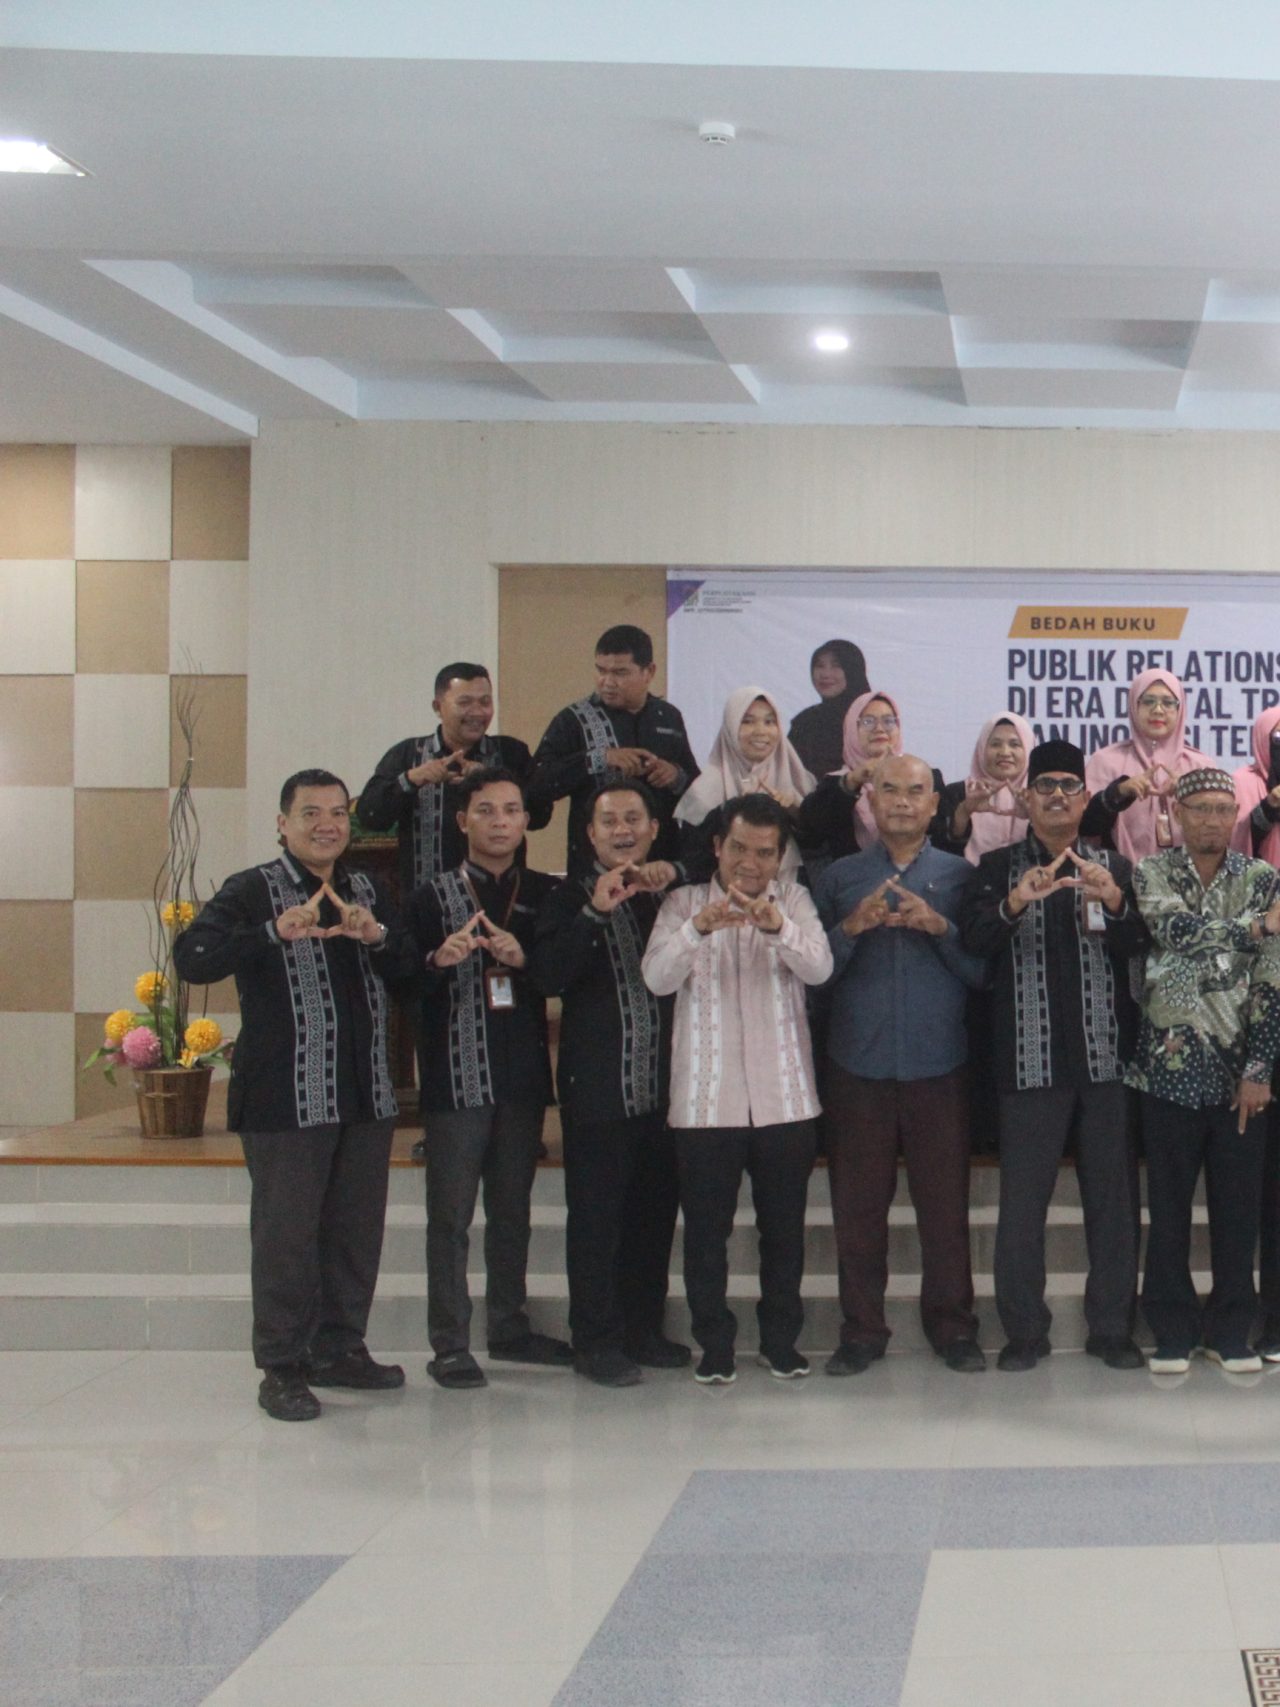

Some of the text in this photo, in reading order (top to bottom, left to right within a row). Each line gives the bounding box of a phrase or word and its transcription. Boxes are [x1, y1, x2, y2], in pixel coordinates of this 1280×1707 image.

[1030, 616, 1156, 632] BEDAH BUKU
[1008, 648, 1117, 682] PUBLIK
[1008, 686, 1036, 719] DI
[1046, 686, 1105, 719] ERA
